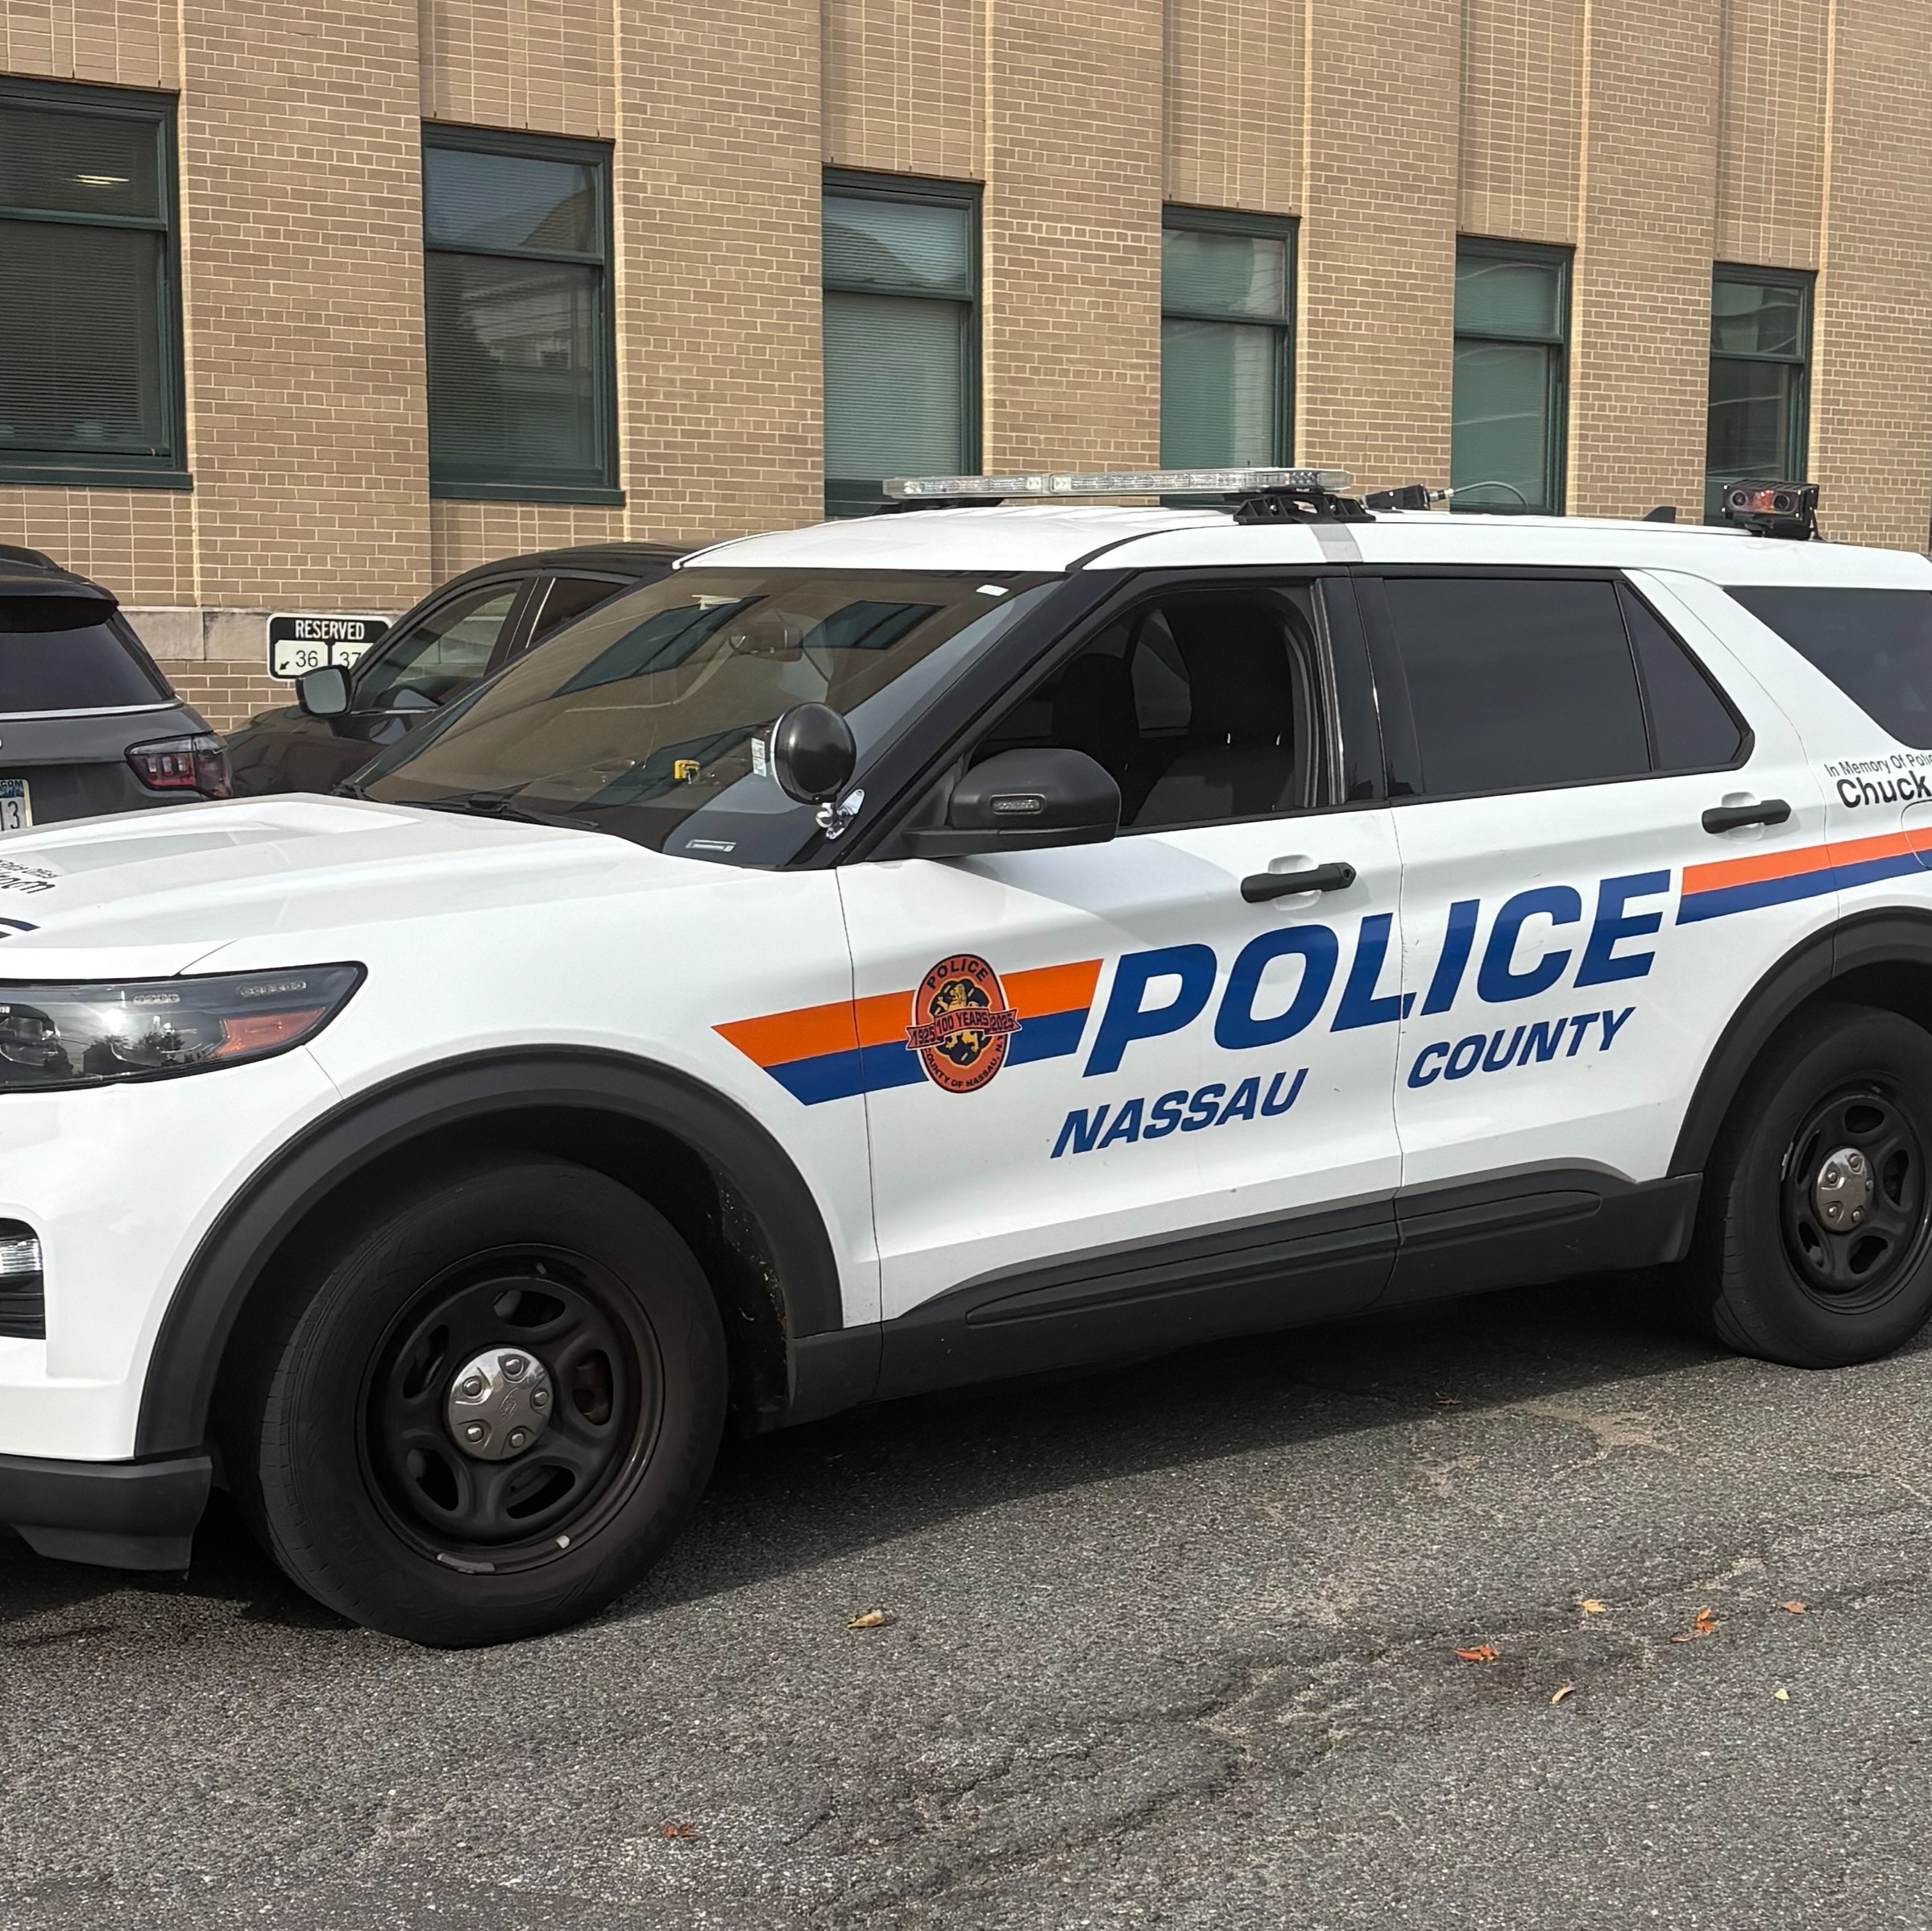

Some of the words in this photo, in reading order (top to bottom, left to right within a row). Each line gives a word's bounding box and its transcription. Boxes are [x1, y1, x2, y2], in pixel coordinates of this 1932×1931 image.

[295, 619, 365, 640] RESERVED
[295, 650, 318, 667] 36
[1824, 764, 1840, 777] In
[1839, 760, 1891, 776] Memory
[1890, 754, 1906, 769] Of
[1837, 770, 1932, 808] Chuck
[927, 959, 989, 989] POLICE
[1084, 870, 1670, 1076] POLICE
[912, 1026, 935, 1045] 1925
[936, 1016, 953, 1034] 100
[957, 1012, 989, 1028] YEARS
[991, 1014, 1014, 1031] 2025
[1409, 1007, 1636, 1088] COUNTY
[951, 1079, 964, 1088] OF
[1051, 1067, 1308, 1158] NASSAU
